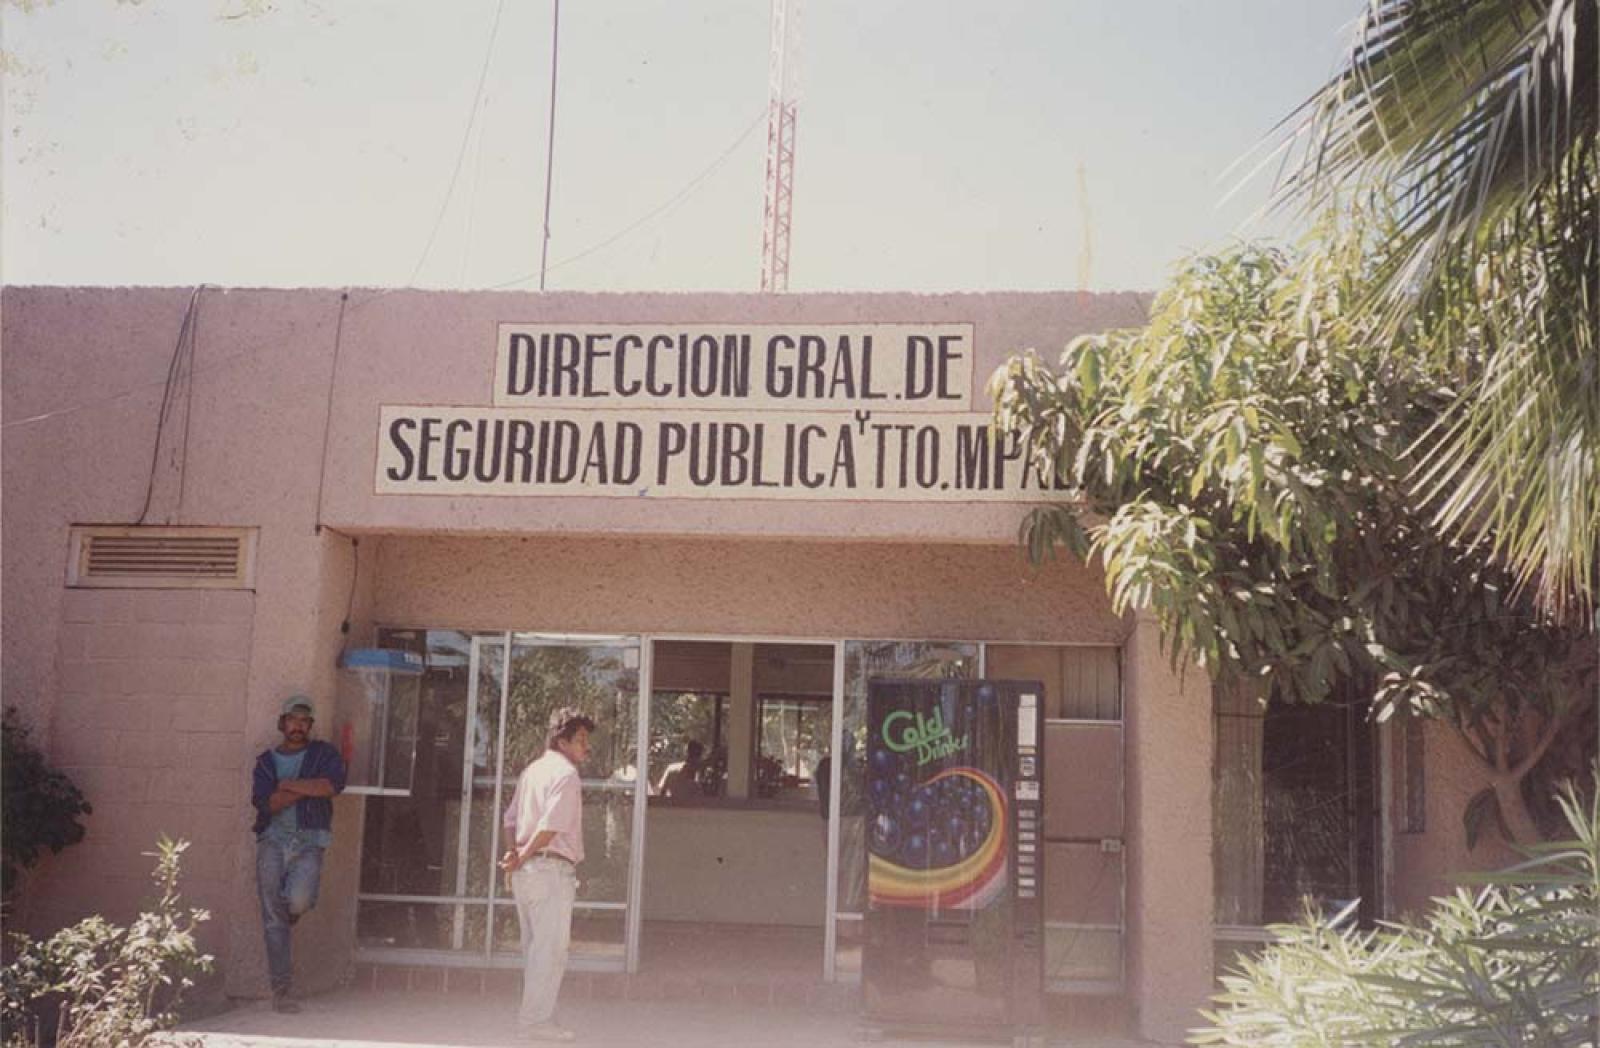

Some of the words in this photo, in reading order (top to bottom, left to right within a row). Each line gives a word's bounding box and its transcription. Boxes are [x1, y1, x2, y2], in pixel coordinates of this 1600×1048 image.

[507, 333, 751, 398] DIRECCION
[386, 418, 643, 486] SEGURIDAD
[656, 422, 857, 489] PUBLICA
[855, 409, 871, 436] Y
[882, 705, 951, 752] Cold
[917, 733, 969, 766] Drinks
